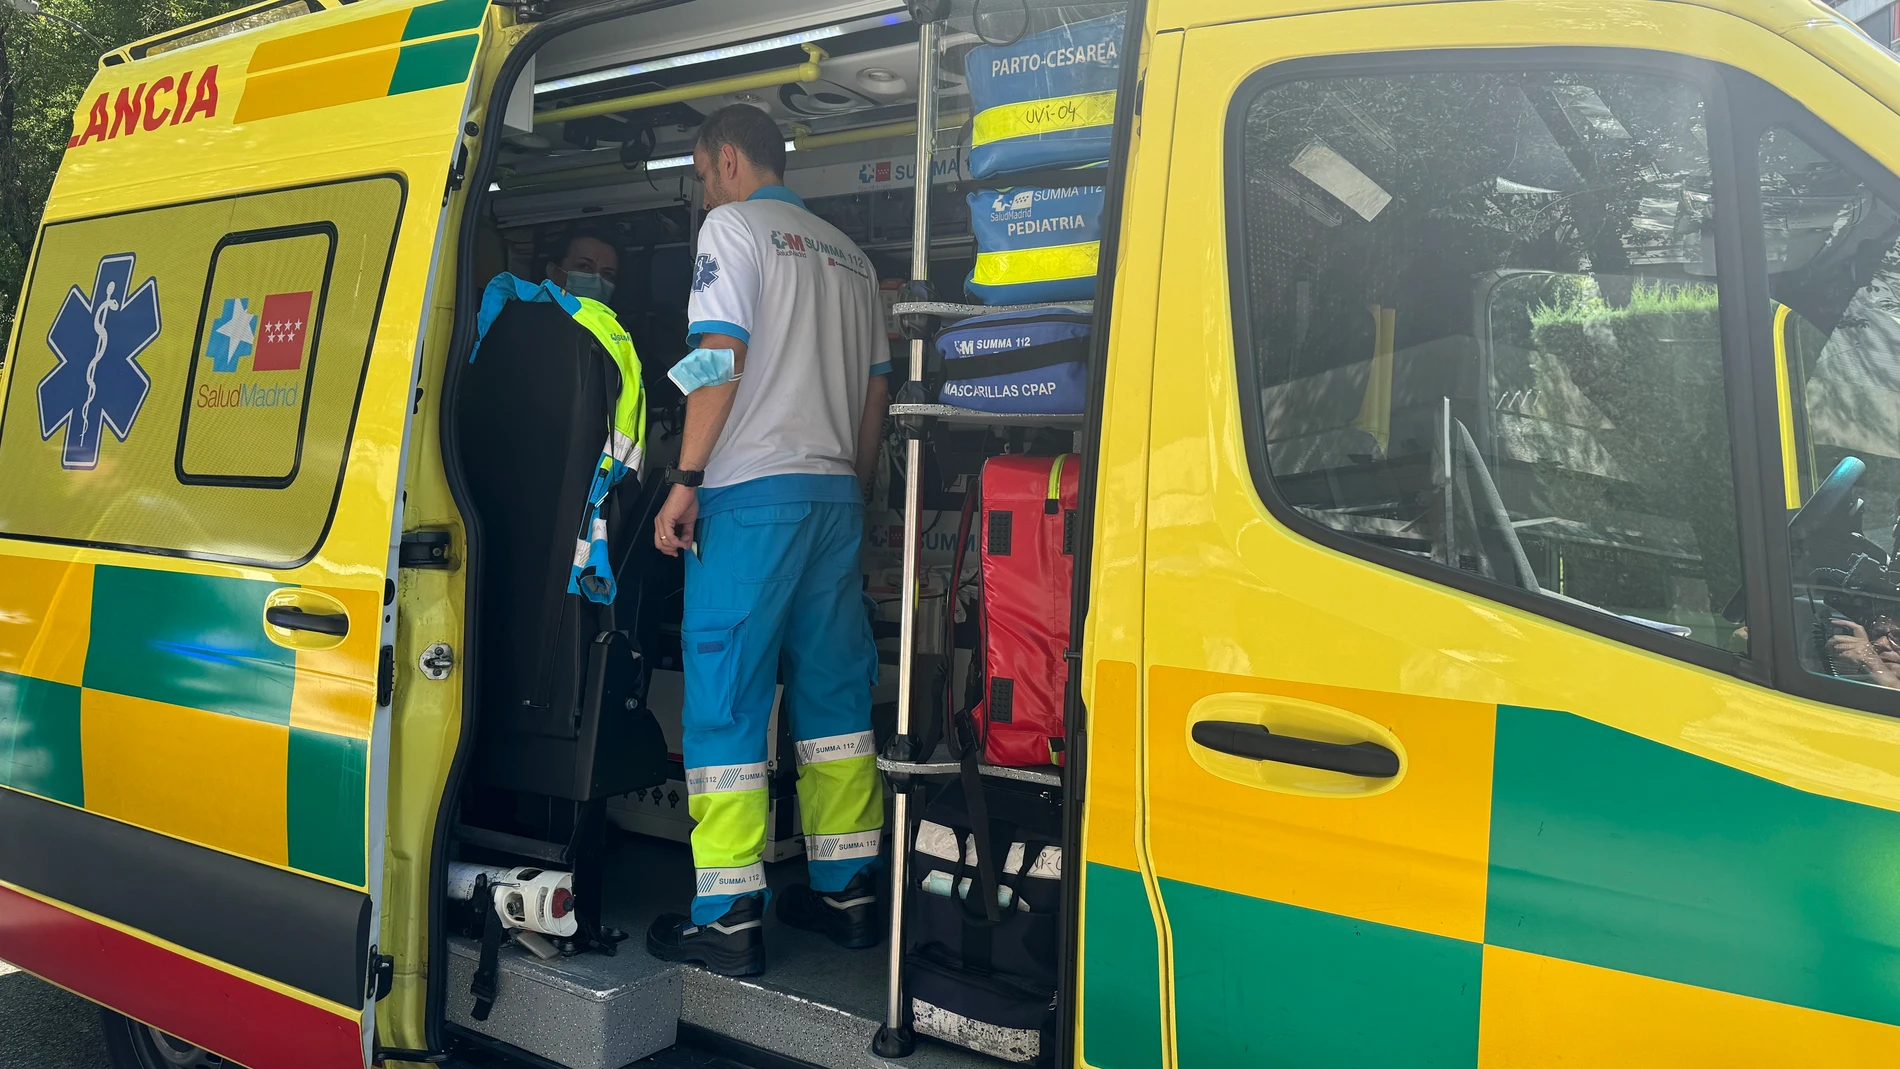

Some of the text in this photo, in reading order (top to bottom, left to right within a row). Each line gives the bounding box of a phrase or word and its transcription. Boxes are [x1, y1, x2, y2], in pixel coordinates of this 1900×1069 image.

[991, 41, 1117, 78] PARTO-CESAREA
[895, 158, 959, 180] SUMA
[1033, 186, 1079, 202] SUMMA
[990, 207, 1032, 222] SaludMadrid
[1007, 215, 1086, 236] PEDIATRIA
[804, 237, 846, 261] SUMMA
[847, 253, 864, 269] 112
[976, 338, 1012, 350] SUMMA
[1016, 337, 1031, 347] 112
[197, 382, 299, 408] SaludMadrid
[944, 382, 1057, 398] MASCARILLAS CPAP
[815, 742, 855, 754] SUMMA 112
[739, 772, 764, 780] SUMMA
[838, 842, 864, 850] SUMMA
[719, 874, 760, 885] SUMMA 112
